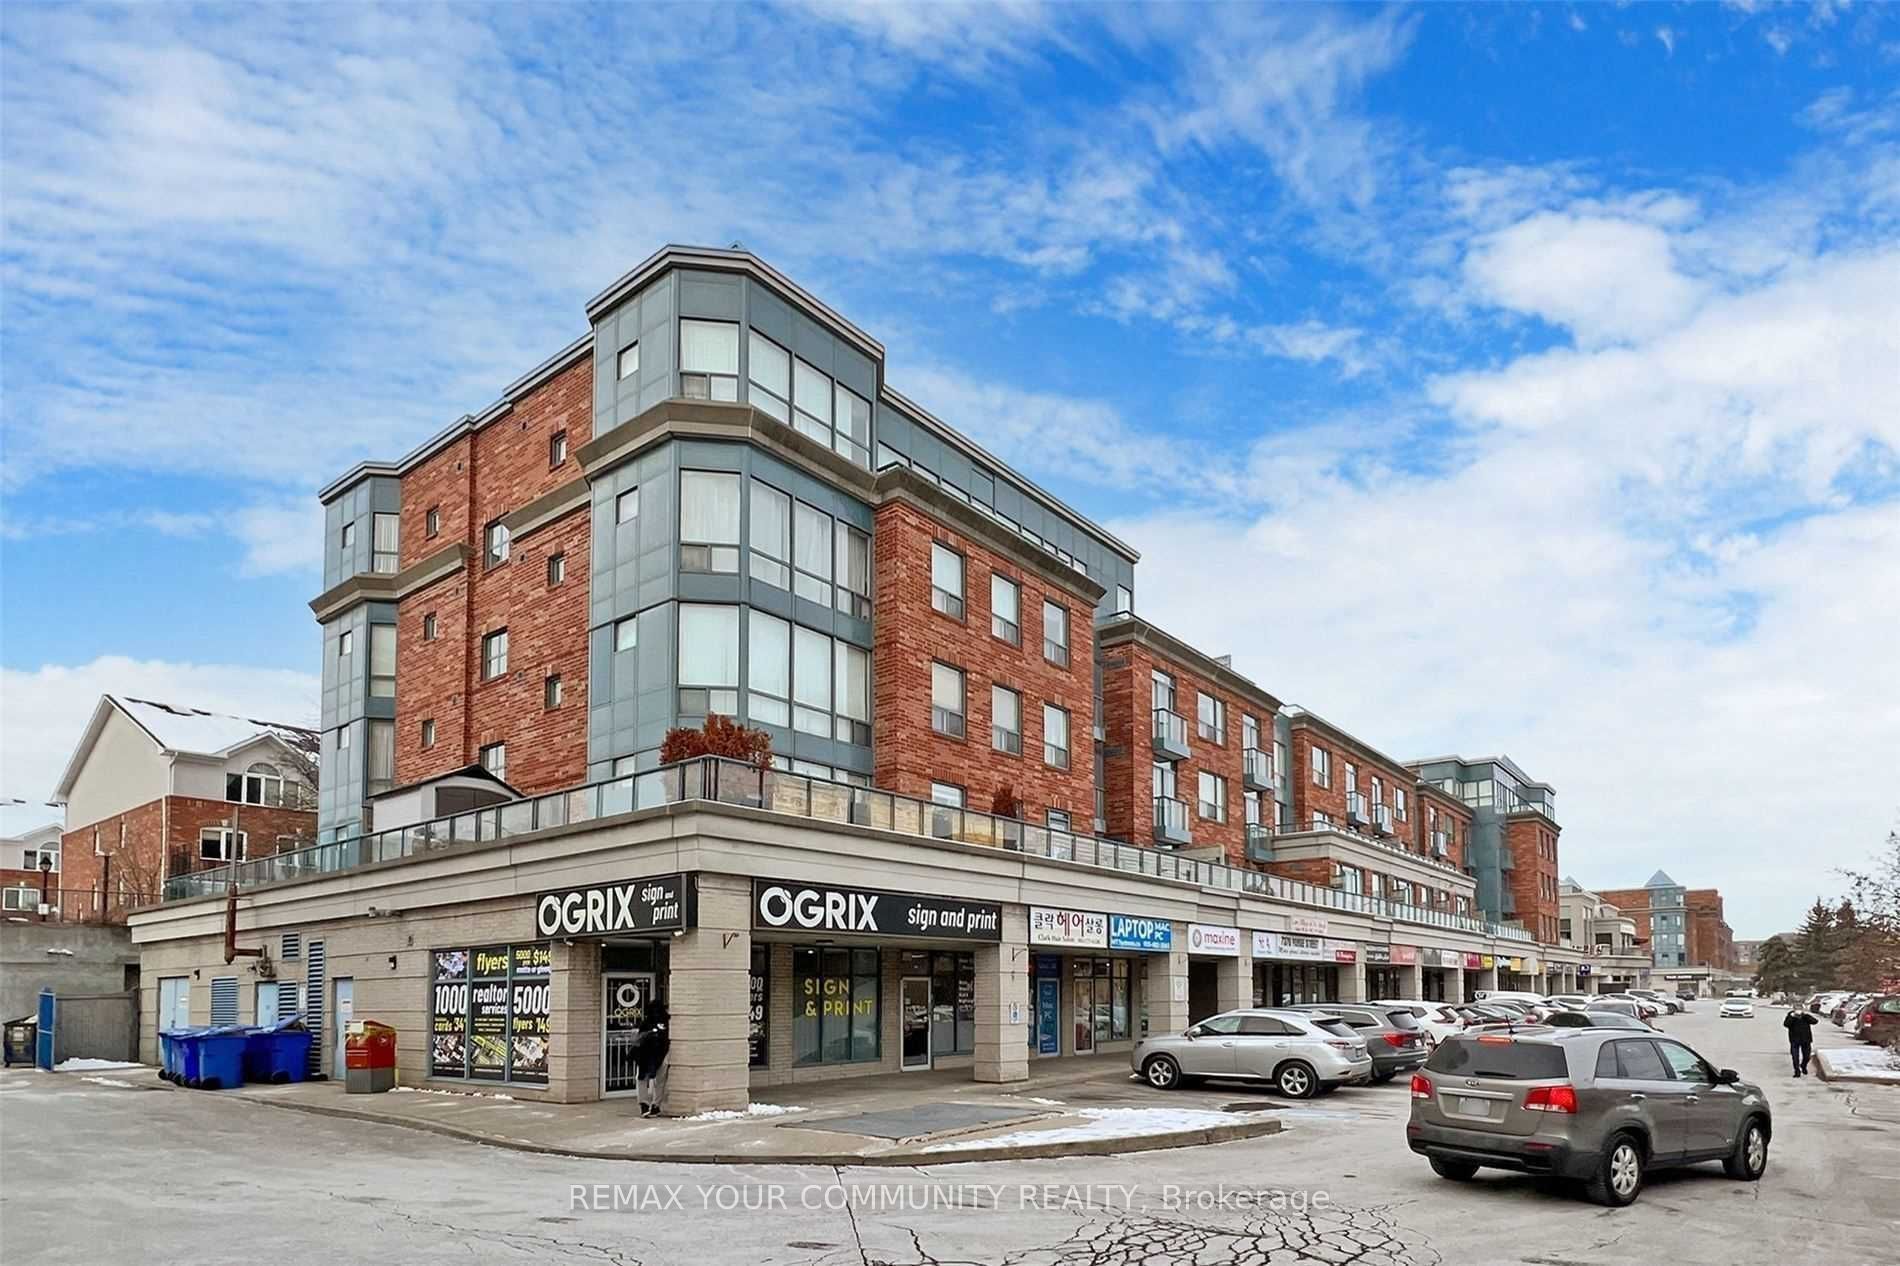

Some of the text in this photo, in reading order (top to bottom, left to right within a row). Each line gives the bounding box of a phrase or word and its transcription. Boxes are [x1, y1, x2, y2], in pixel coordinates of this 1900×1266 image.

[538, 883, 664, 936] OGRIX sign
[652, 901, 679, 925] print
[760, 886, 997, 933] OGRIX sign and print
[1111, 917, 1170, 939] LAPTOP MAC
[1154, 931, 1164, 940] PC
[1204, 930, 1236, 946] maxine
[476, 952, 509, 975] flyers
[472, 983, 508, 1003] realtor
[804, 977, 850, 995] SIGN
[435, 985, 467, 1015] 1000
[513, 985, 550, 1015] 5000
[805, 1000, 873, 1017] & PRINT
[512, 1017, 533, 1033] flyers
